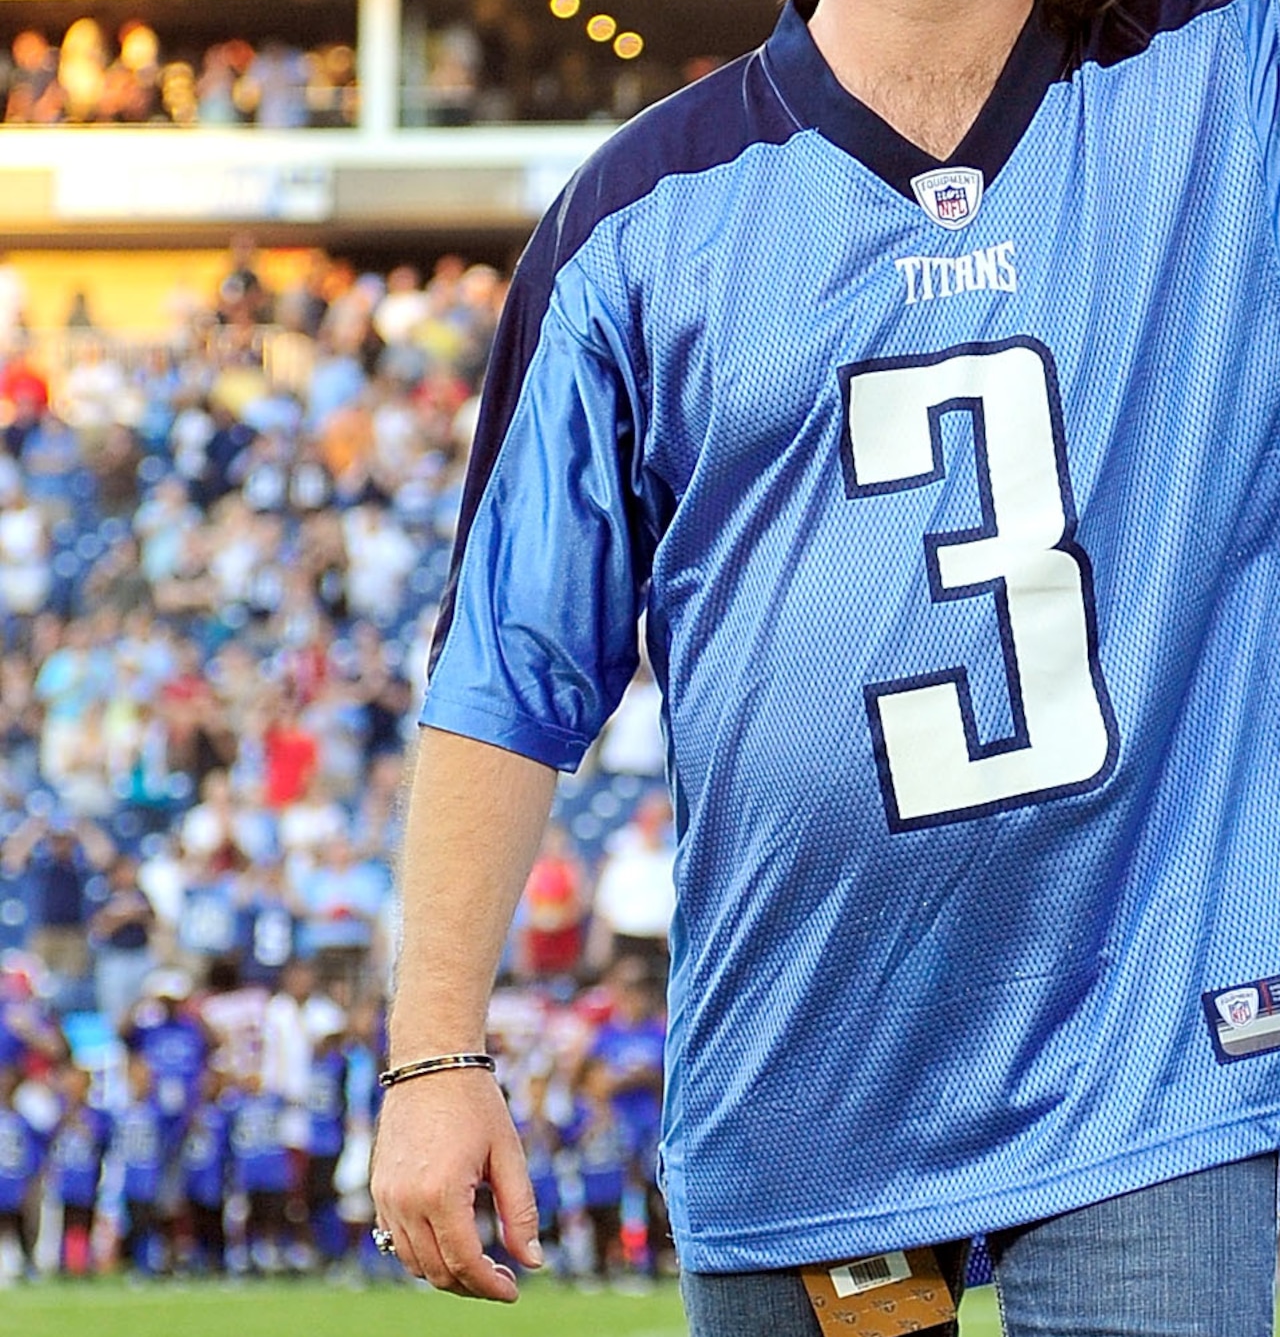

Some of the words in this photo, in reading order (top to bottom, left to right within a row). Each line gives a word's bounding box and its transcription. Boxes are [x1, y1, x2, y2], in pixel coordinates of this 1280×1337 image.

[920, 175, 976, 192] EQUIPMENT
[941, 199, 966, 218] NFL
[894, 240, 1018, 305] TITANS
[836, 335, 1119, 834] 3
